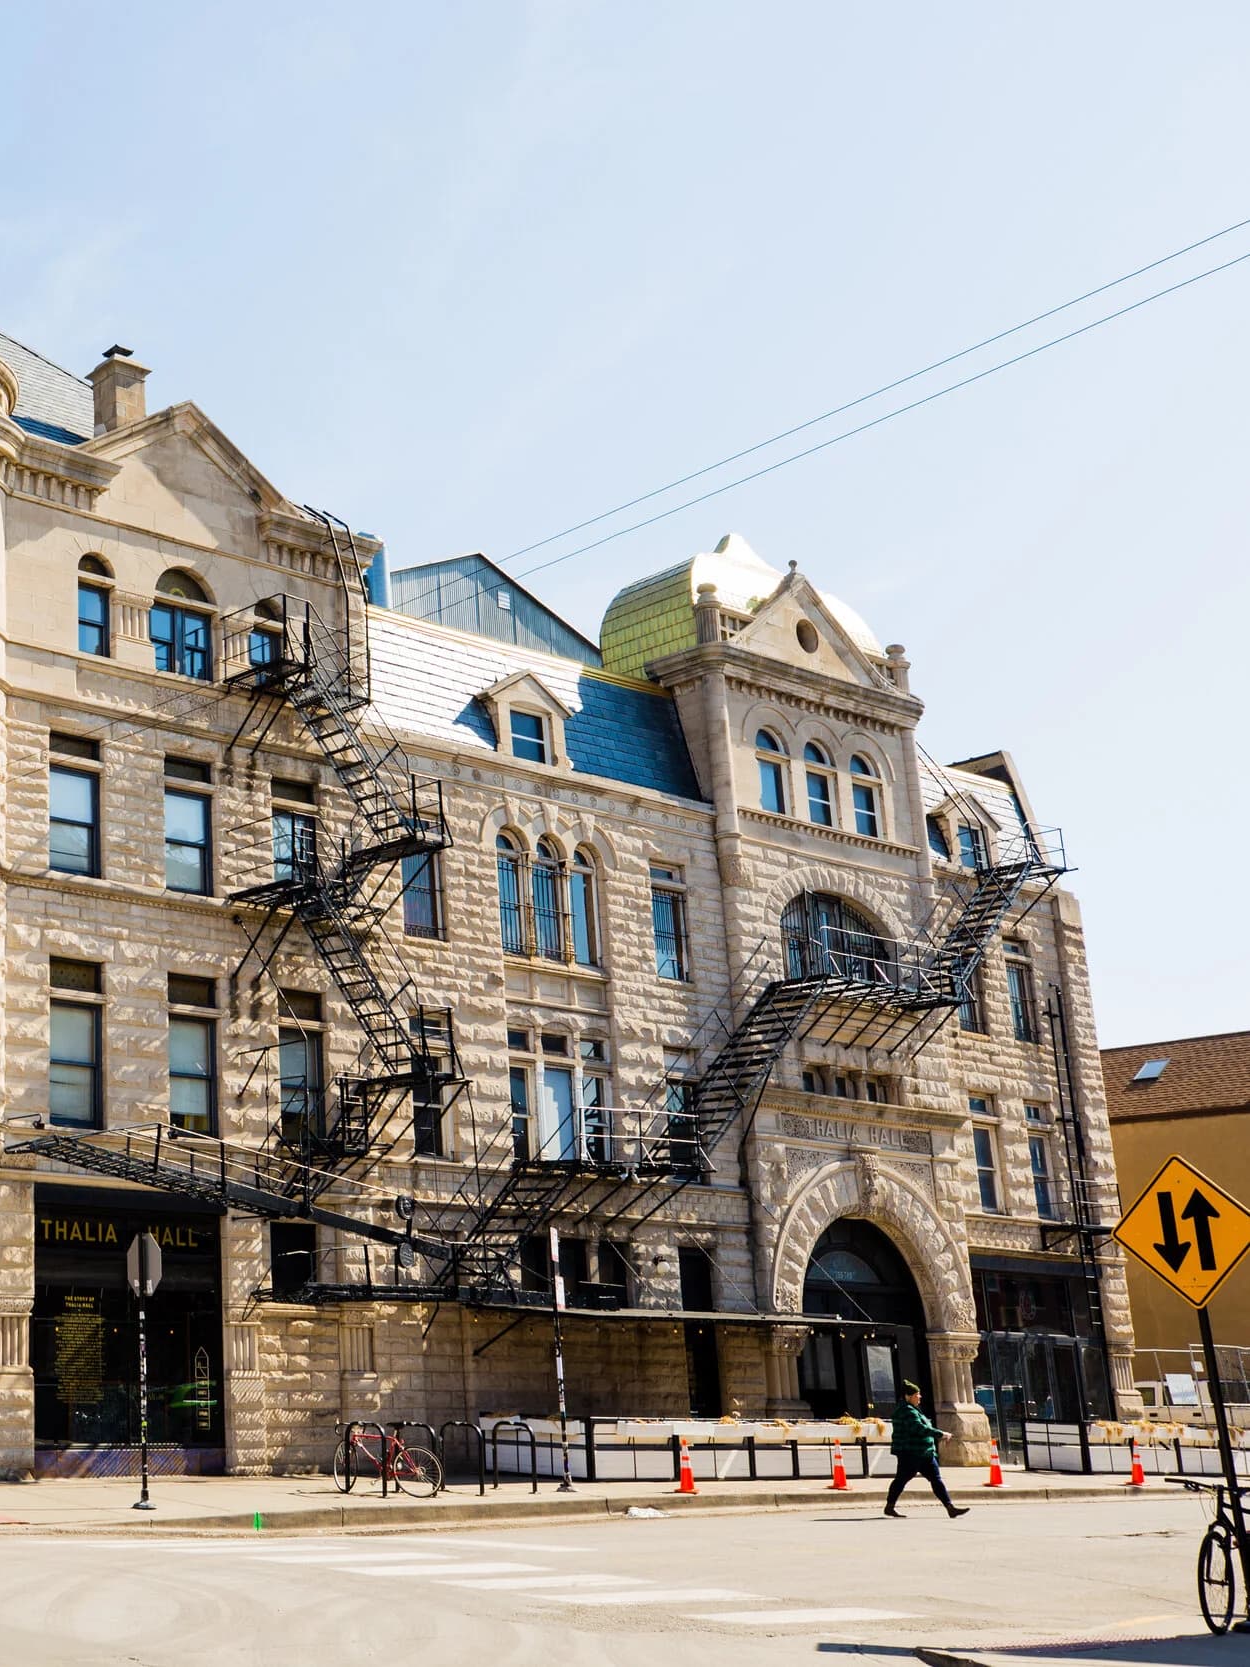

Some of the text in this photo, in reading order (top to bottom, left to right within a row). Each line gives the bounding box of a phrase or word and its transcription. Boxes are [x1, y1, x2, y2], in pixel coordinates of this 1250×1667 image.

[805, 1117, 910, 1147] THALIA HALL
[40, 1218, 198, 1248] THALIA HALL
